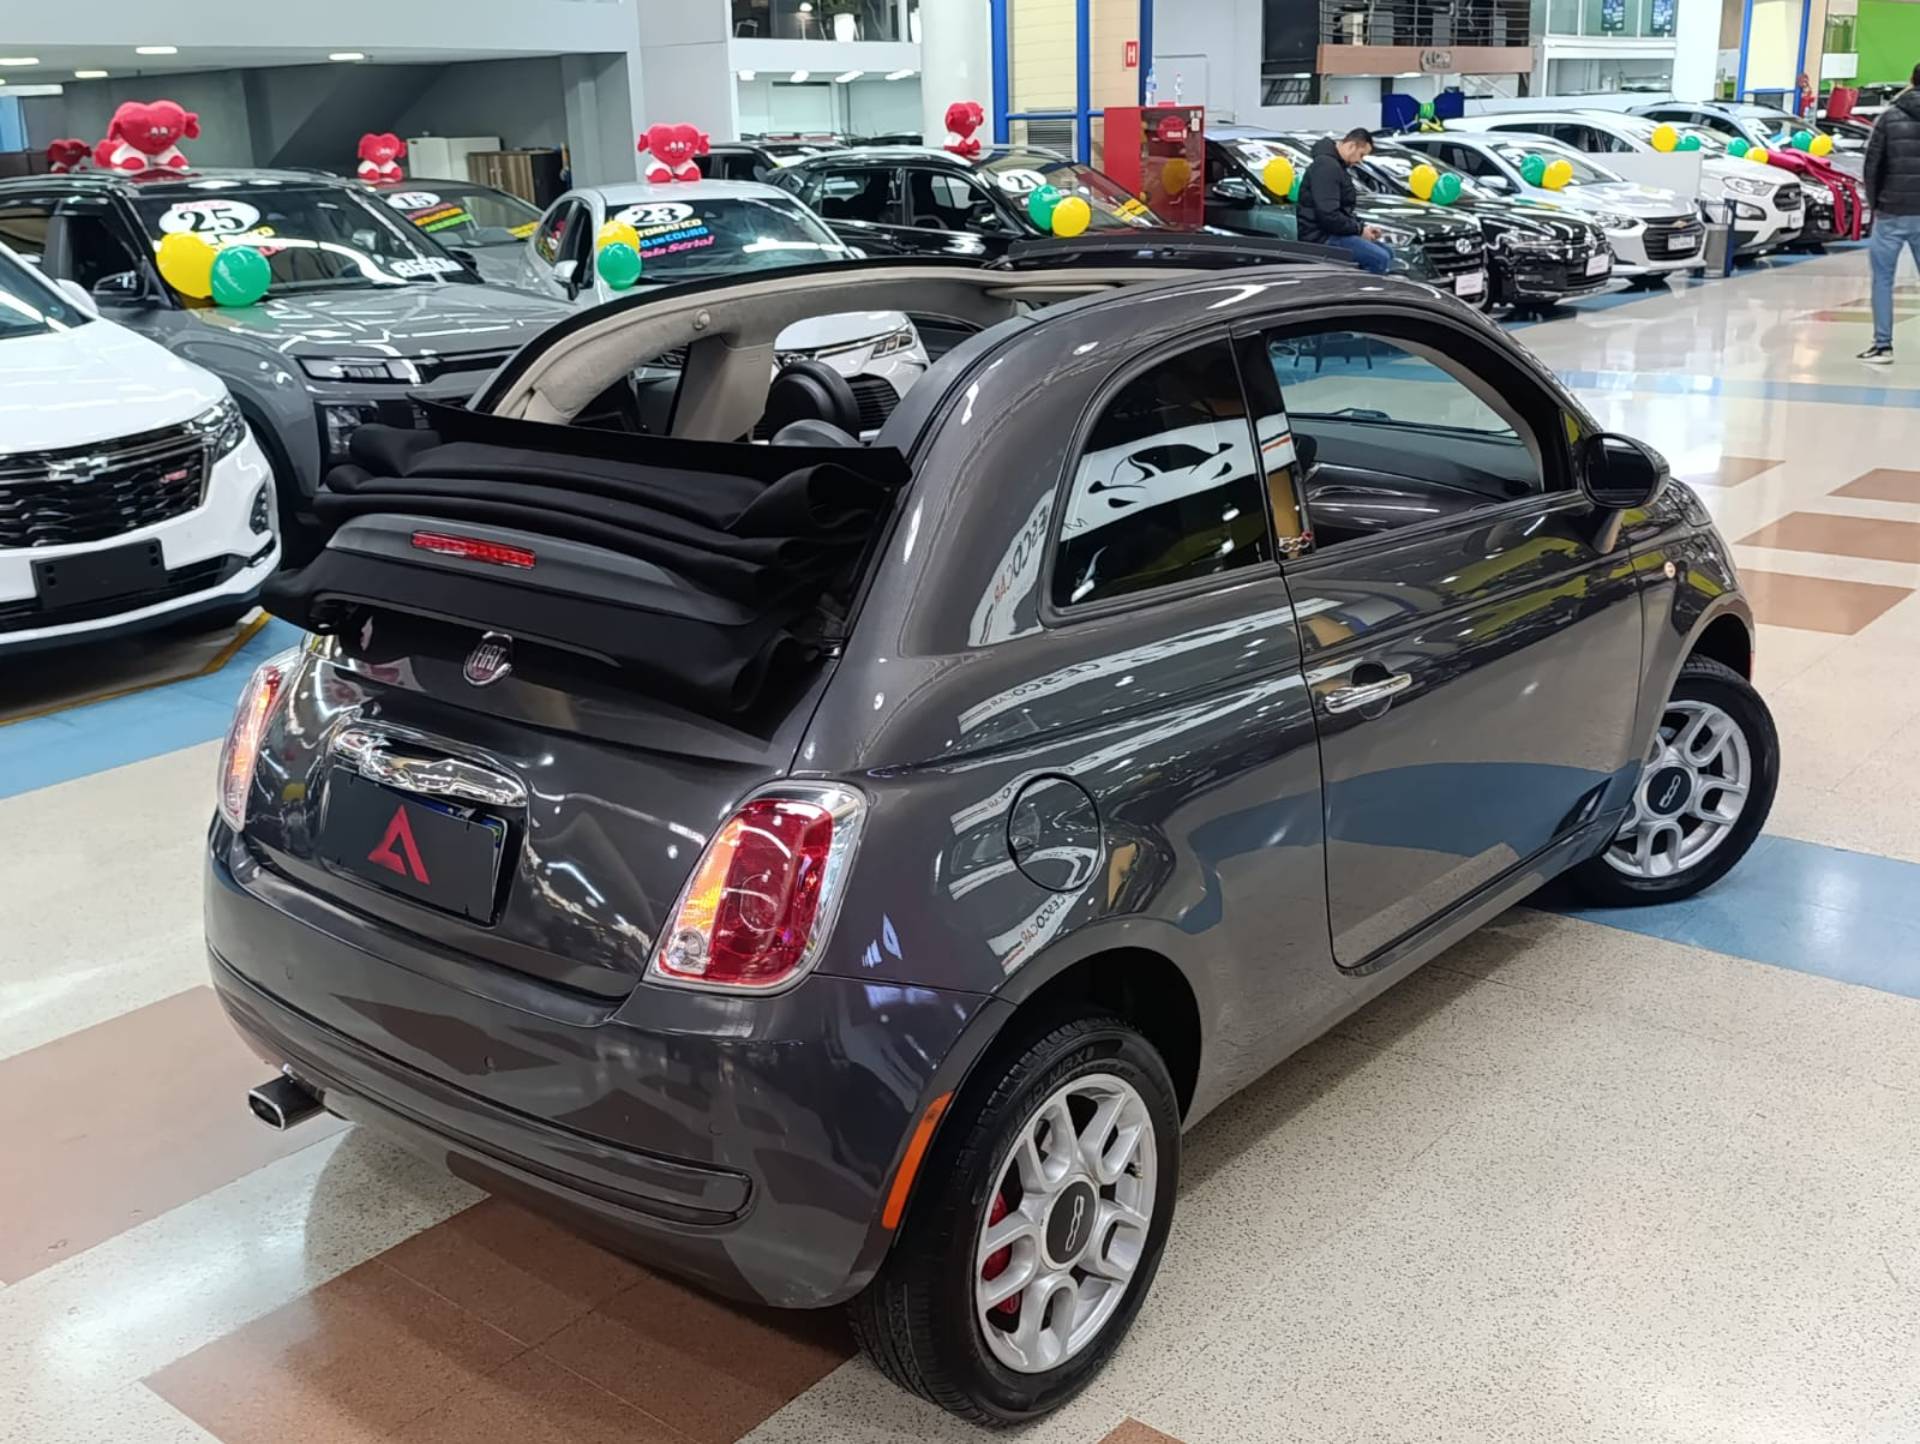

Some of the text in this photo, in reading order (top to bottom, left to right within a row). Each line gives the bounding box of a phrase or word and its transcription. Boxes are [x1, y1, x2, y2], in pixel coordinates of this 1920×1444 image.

[1126, 44, 1136, 65] H
[177, 208, 245, 232] 25
[631, 207, 680, 224] 23
[472, 643, 507, 671] FIAT
